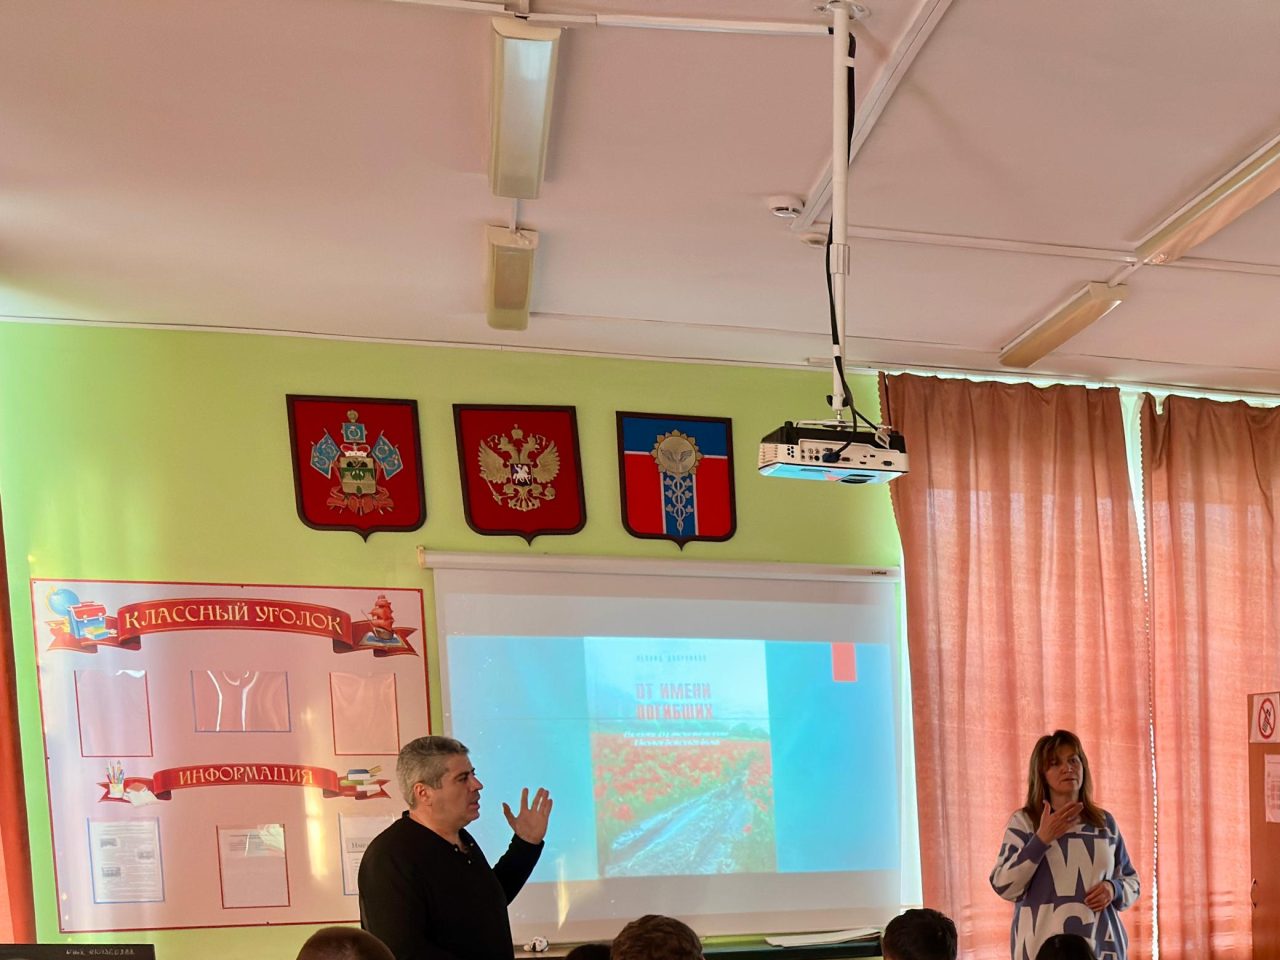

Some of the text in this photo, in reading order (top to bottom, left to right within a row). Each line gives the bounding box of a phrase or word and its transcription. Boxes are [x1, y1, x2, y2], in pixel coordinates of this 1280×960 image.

[125, 603, 342, 634] КЛАССНЫЙ УГОЛОК
[636, 683, 711, 700] ОТ ИМЕНИ
[636, 703, 713, 720] ПОГИБШИХ
[178, 766, 313, 785] ИНФОРМАЦИЯ
